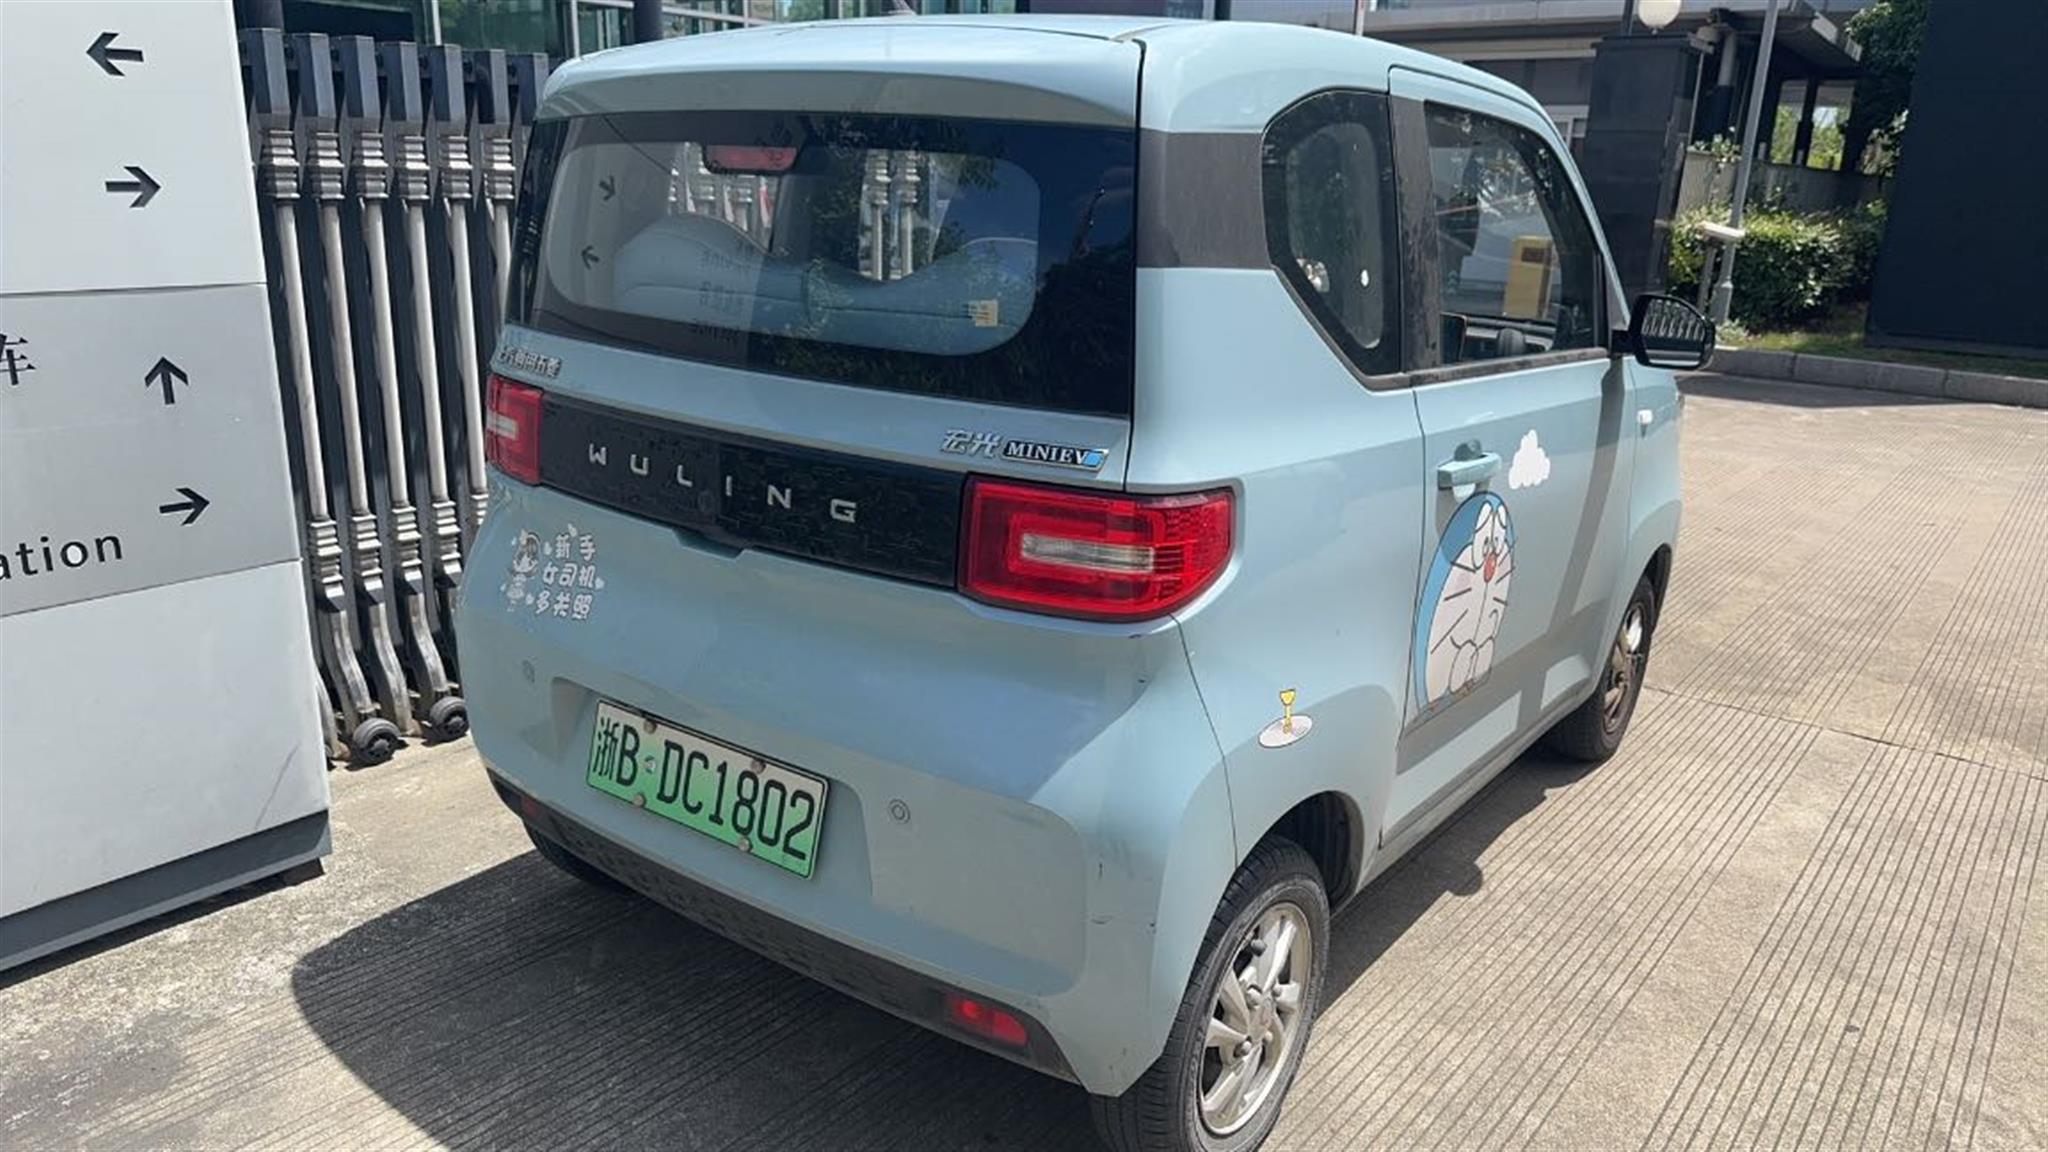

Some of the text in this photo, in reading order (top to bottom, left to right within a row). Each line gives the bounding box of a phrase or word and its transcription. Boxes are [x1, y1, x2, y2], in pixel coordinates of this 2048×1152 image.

[941, 429, 1090, 466] 宏光 MINIEV
[588, 443, 857, 523] WULING
[555, 533, 596, 561] 新手
[542, 561, 596, 588] 女司机
[535, 589, 593, 620] 多关照
